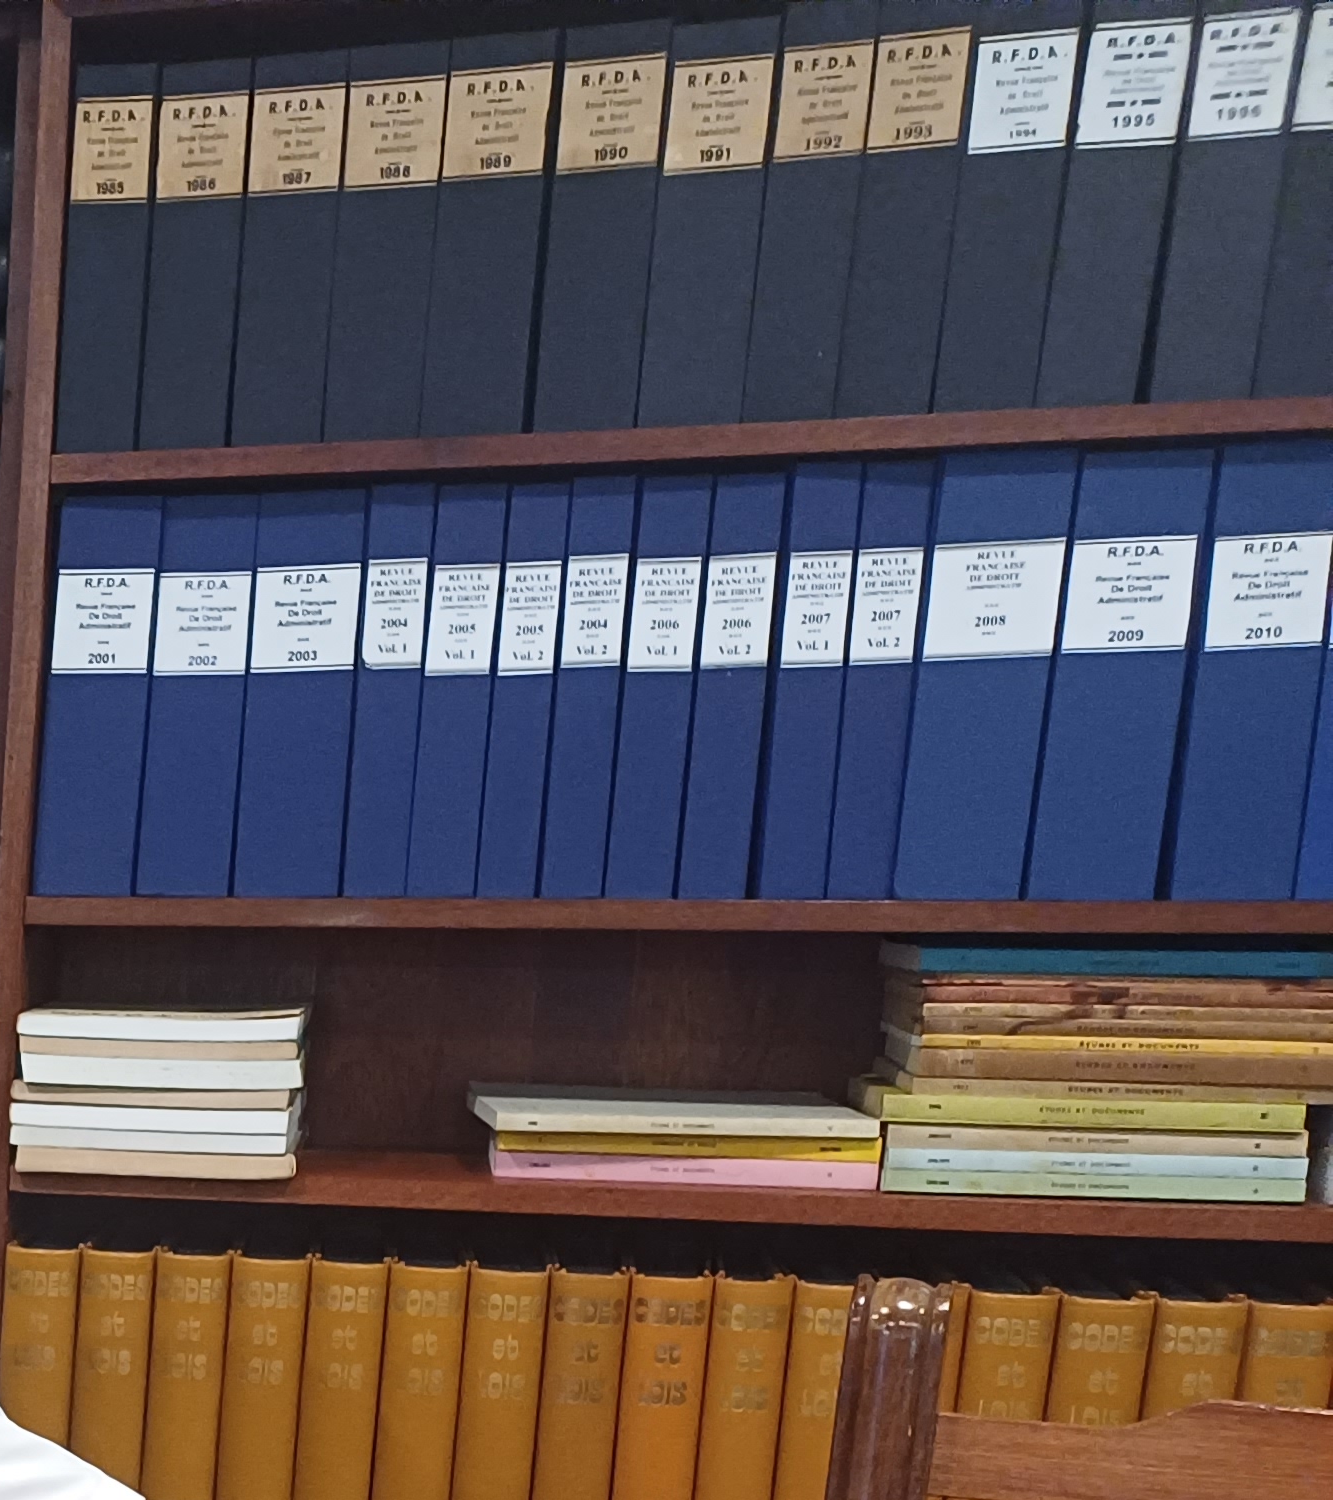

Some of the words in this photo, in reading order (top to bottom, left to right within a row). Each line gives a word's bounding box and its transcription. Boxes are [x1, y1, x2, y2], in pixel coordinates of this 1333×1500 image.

[1112, 113, 1155, 128] 1995
[894, 125, 932, 141] 1993
[804, 135, 842, 151] 1992
[594, 147, 628, 163] 1990
[700, 148, 730, 163] 1991
[480, 155, 512, 170] 1989
[380, 163, 411, 180] 1988
[282, 171, 311, 185] 1987
[96, 180, 124, 195] 1985
[186, 178, 216, 192] 1986
[1111, 585, 1125, 593] De
[1248, 581, 1262, 590] De
[801, 613, 831, 625] 2007
[871, 610, 901, 622] 2007
[975, 615, 1006, 627] 2008
[381, 618, 408, 629] 2004
[448, 623, 476, 634] 2005
[579, 619, 607, 630] 2004
[650, 619, 679, 630] 2006
[722, 619, 751, 630] 2006
[516, 624, 544, 636] 2005
[1108, 629, 1144, 642] 2009
[1245, 626, 1282, 640] 2010
[88, 653, 115, 664] 2001
[188, 656, 217, 666] 2002
[287, 650, 317, 662] 2003
[493, 1334, 519, 1361] et
[654, 1342, 681, 1367] et
